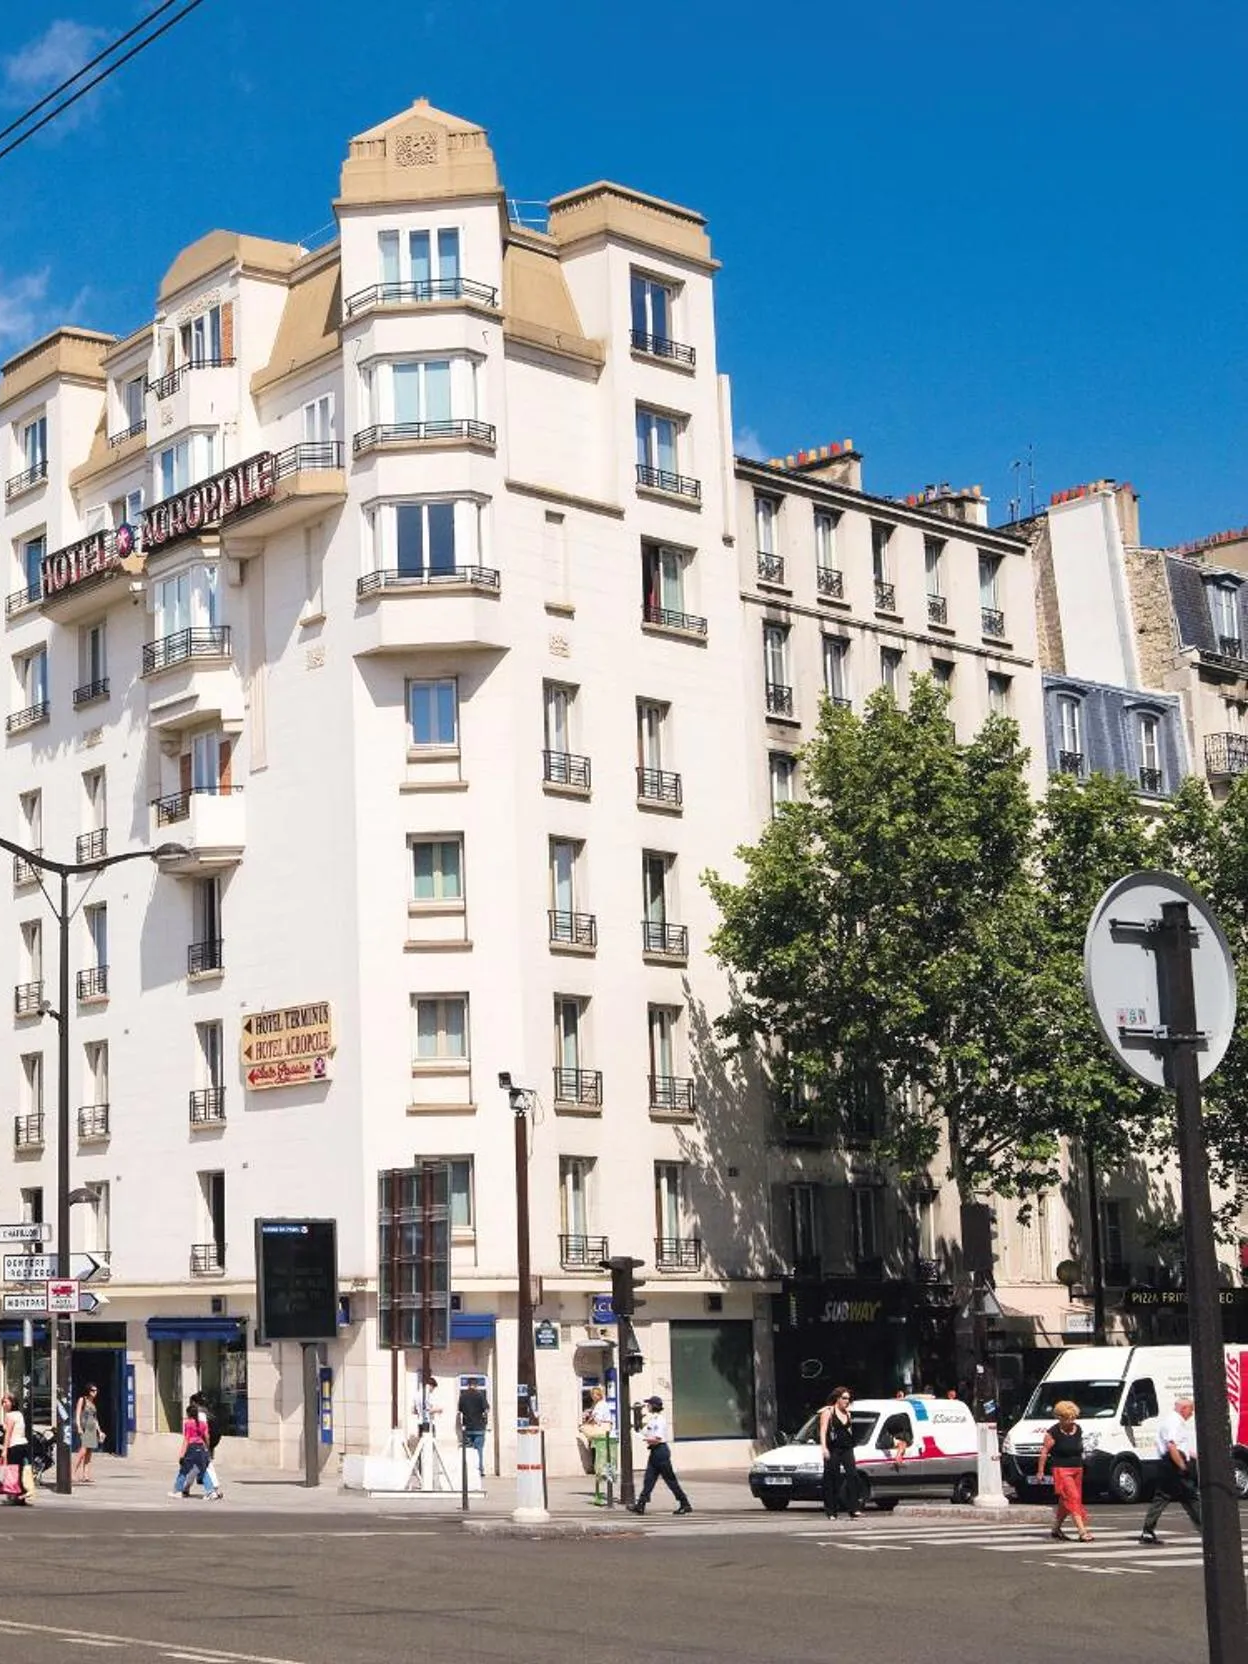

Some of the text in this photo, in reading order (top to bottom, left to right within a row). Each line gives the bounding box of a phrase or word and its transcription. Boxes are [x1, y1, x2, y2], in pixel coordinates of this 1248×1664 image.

[42, 453, 274, 594] HOTEL ACROPOLE
[255, 1013, 282, 1034] HOTEL
[255, 1038, 283, 1060] HOTEL
[6, 1258, 45, 1267] DENFERT
[1132, 1292, 1158, 1304] PIZZA
[820, 1301, 882, 1322] SUBWAY
[1225, 1353, 1239, 1413] AVIS
